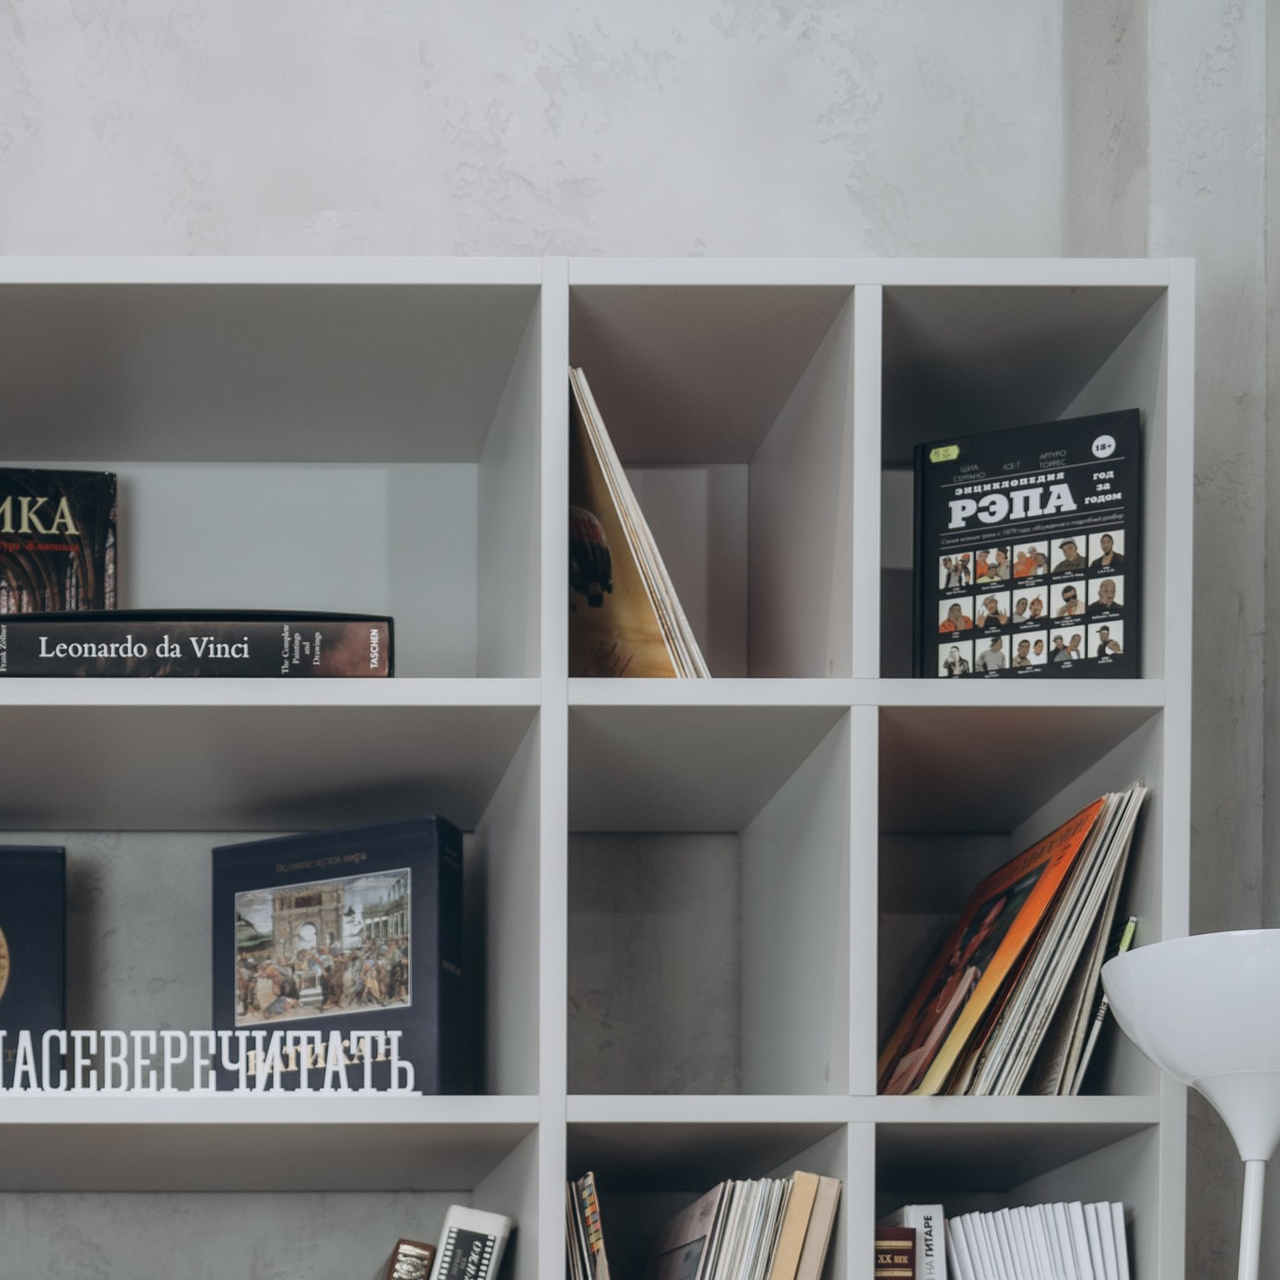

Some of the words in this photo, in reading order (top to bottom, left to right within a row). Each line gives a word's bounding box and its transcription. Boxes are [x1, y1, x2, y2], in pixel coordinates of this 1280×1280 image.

[1003, 461, 1021, 471] ICE-T
[1039, 459, 1066, 469] ТОРРЕС
[953, 472, 985, 483] СЕРРАНО
[948, 483, 1078, 529] РЭПА
[0, 623, 7, 649] Zöllner
[39, 634, 147, 659] Leonardo
[155, 635, 181, 659] da
[190, 635, 249, 659] Vinci
[281, 623, 290, 656] Complete
[292, 632, 301, 664] Paintings
[313, 632, 322, 665] Drawings
[370, 628, 379, 669] TASCHEN
[0, 650, 7, 672] Frank
[281, 659, 290, 674] The
[922, 1215, 933, 1257] ГИТАРЕ
[924, 1259, 934, 1275] НА
